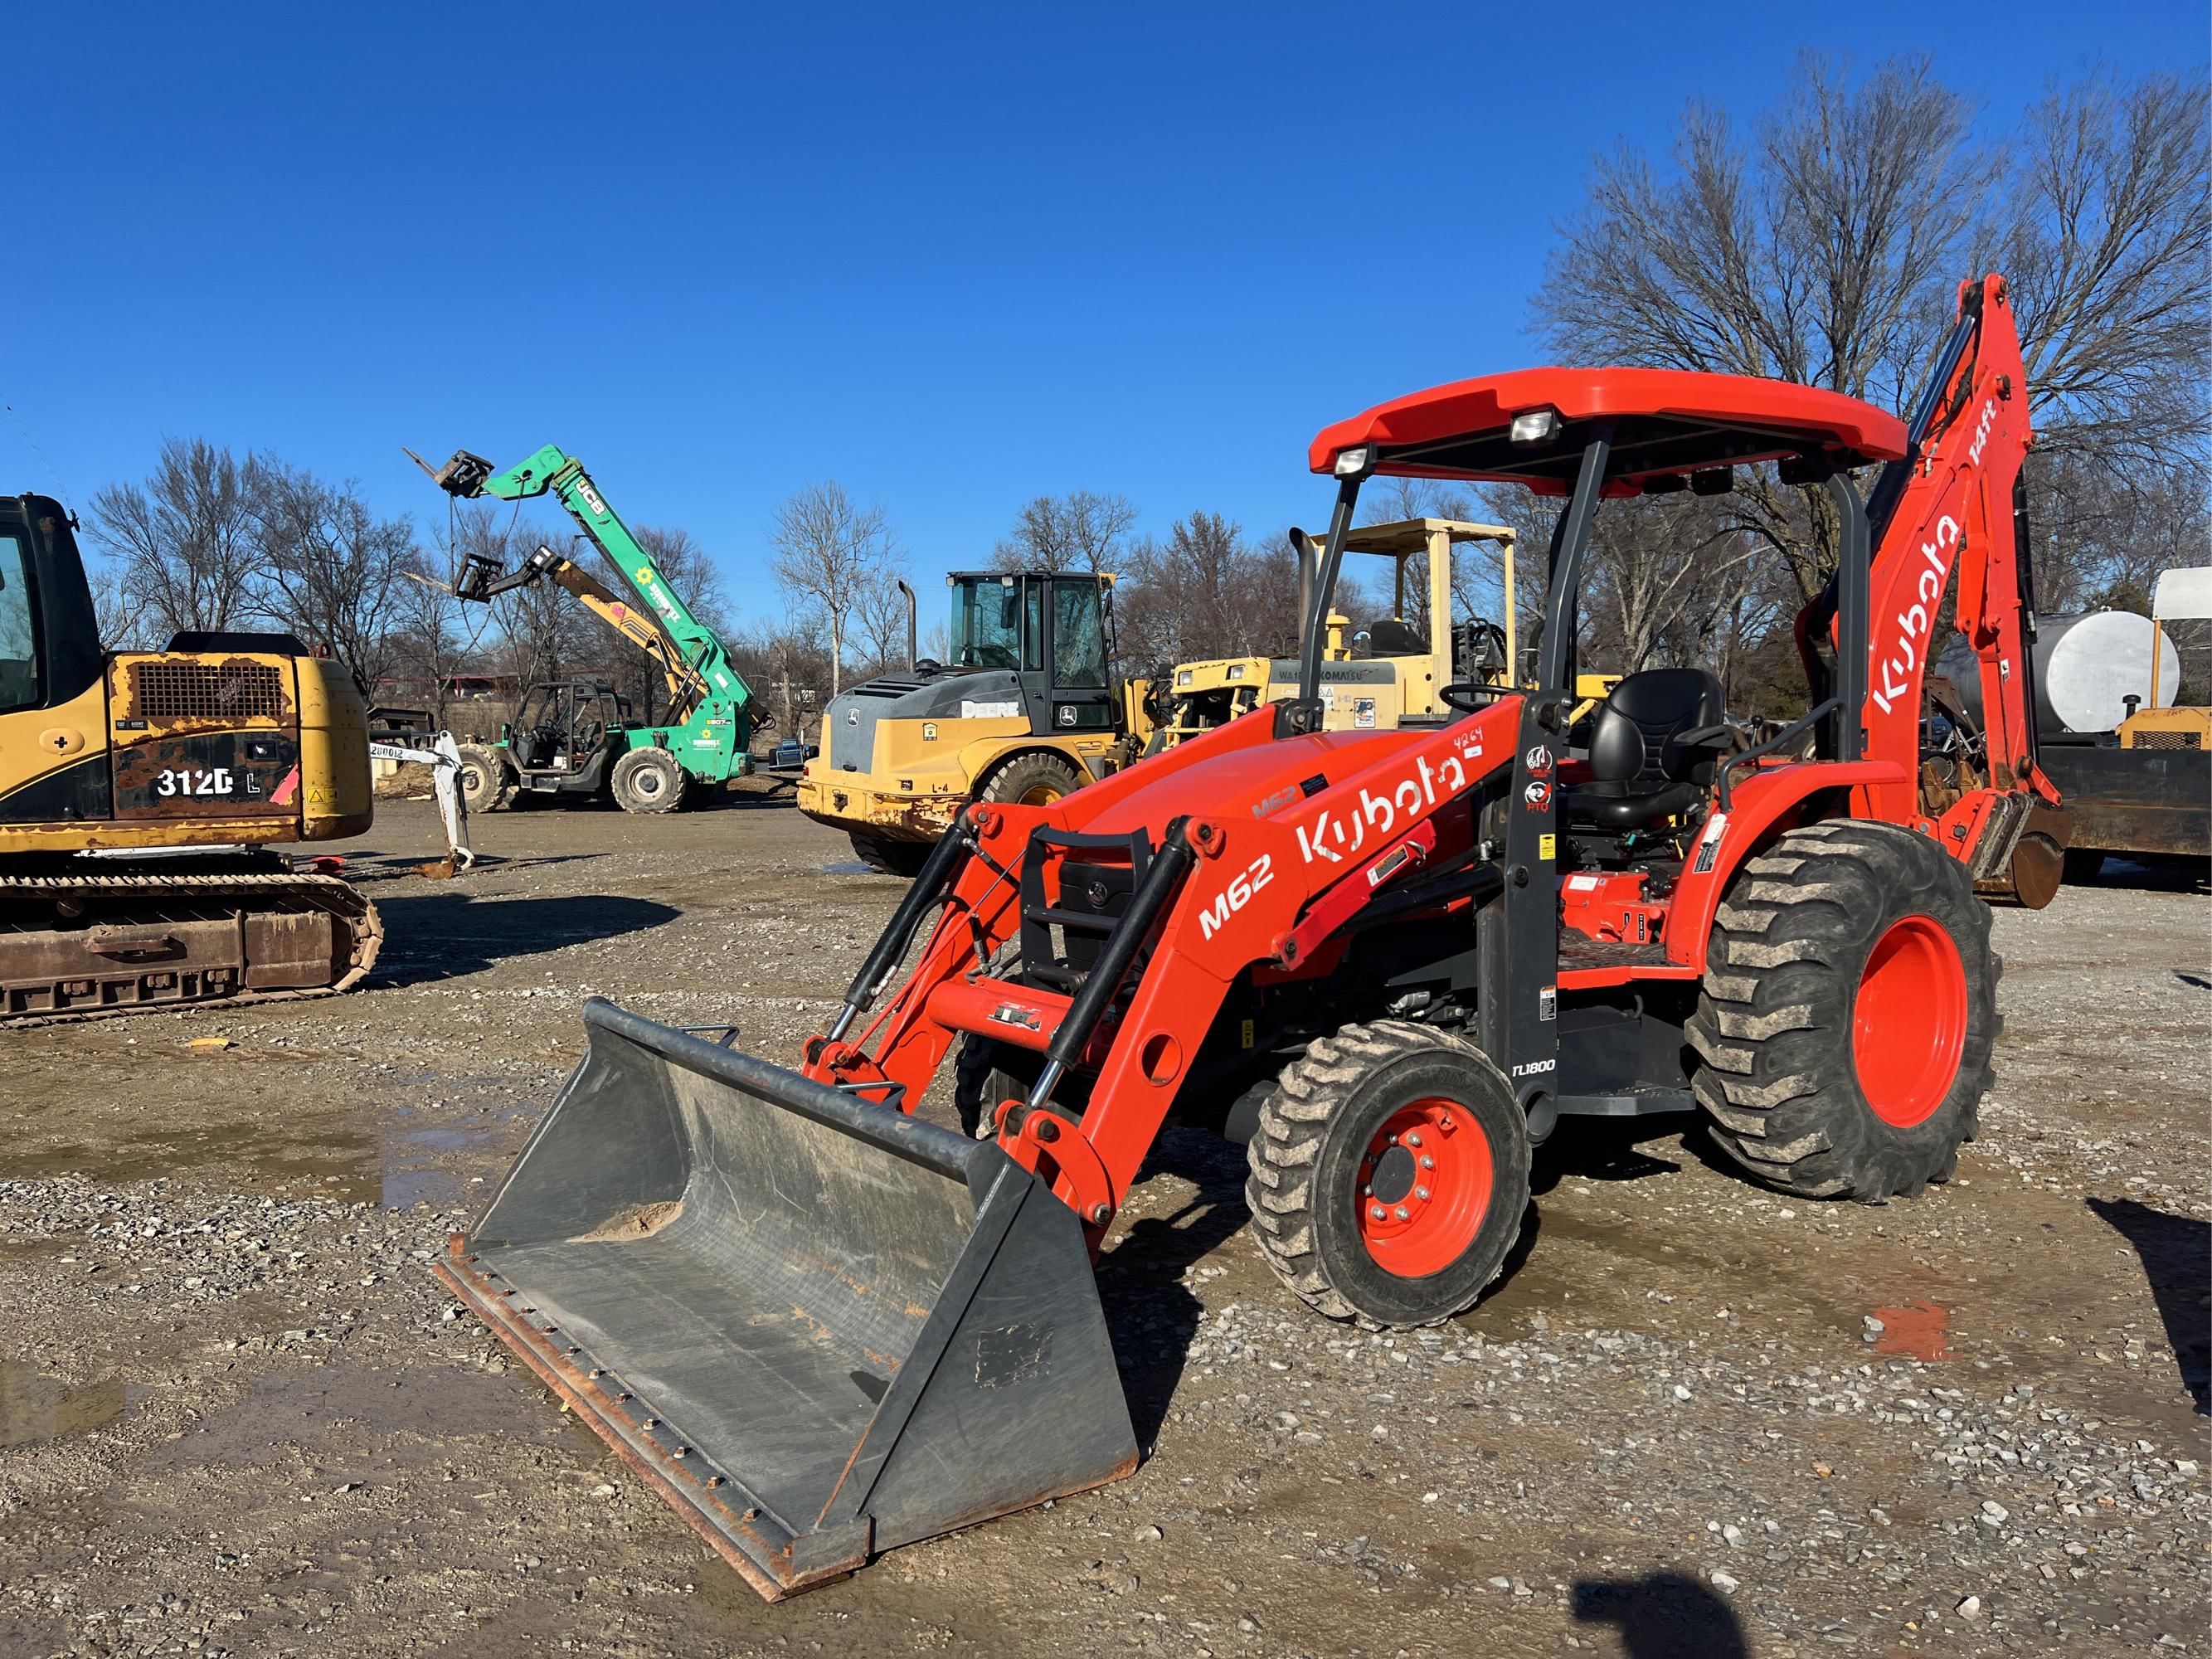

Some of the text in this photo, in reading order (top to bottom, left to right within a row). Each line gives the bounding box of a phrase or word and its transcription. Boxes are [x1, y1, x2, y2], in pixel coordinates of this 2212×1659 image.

[1968, 398, 1997, 467] 14ft
[576, 480, 605, 515] JCB
[1873, 514, 1960, 715] Kubota
[1280, 670, 1362, 681] WA18 KOMATSU
[962, 701, 1019, 718] DEERE
[1454, 726, 1483, 751] 4264
[158, 768, 260, 796] 312D L
[932, 783, 949, 794] L-4
[1252, 785, 1299, 821] M62
[1296, 755, 1466, 864] Kubota
[1198, 853, 1275, 941] M62
[1512, 1058, 1556, 1078] TL1800
